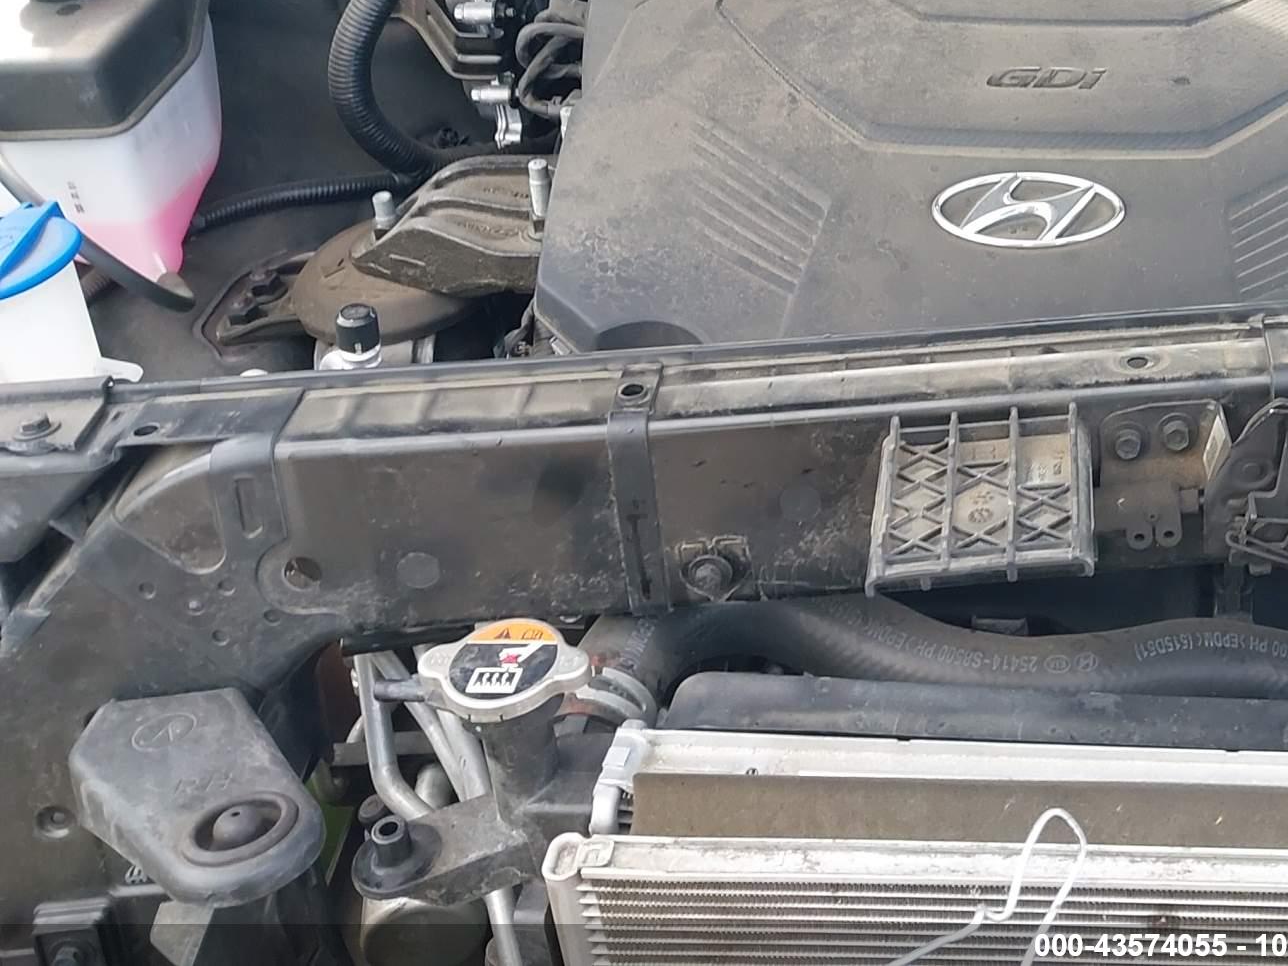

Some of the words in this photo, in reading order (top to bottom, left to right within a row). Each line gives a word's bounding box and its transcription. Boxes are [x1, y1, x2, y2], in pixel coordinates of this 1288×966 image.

[986, 66, 1107, 89] GDi
[915, 638, 937, 659] PH
[1249, 634, 1268, 651] PH
